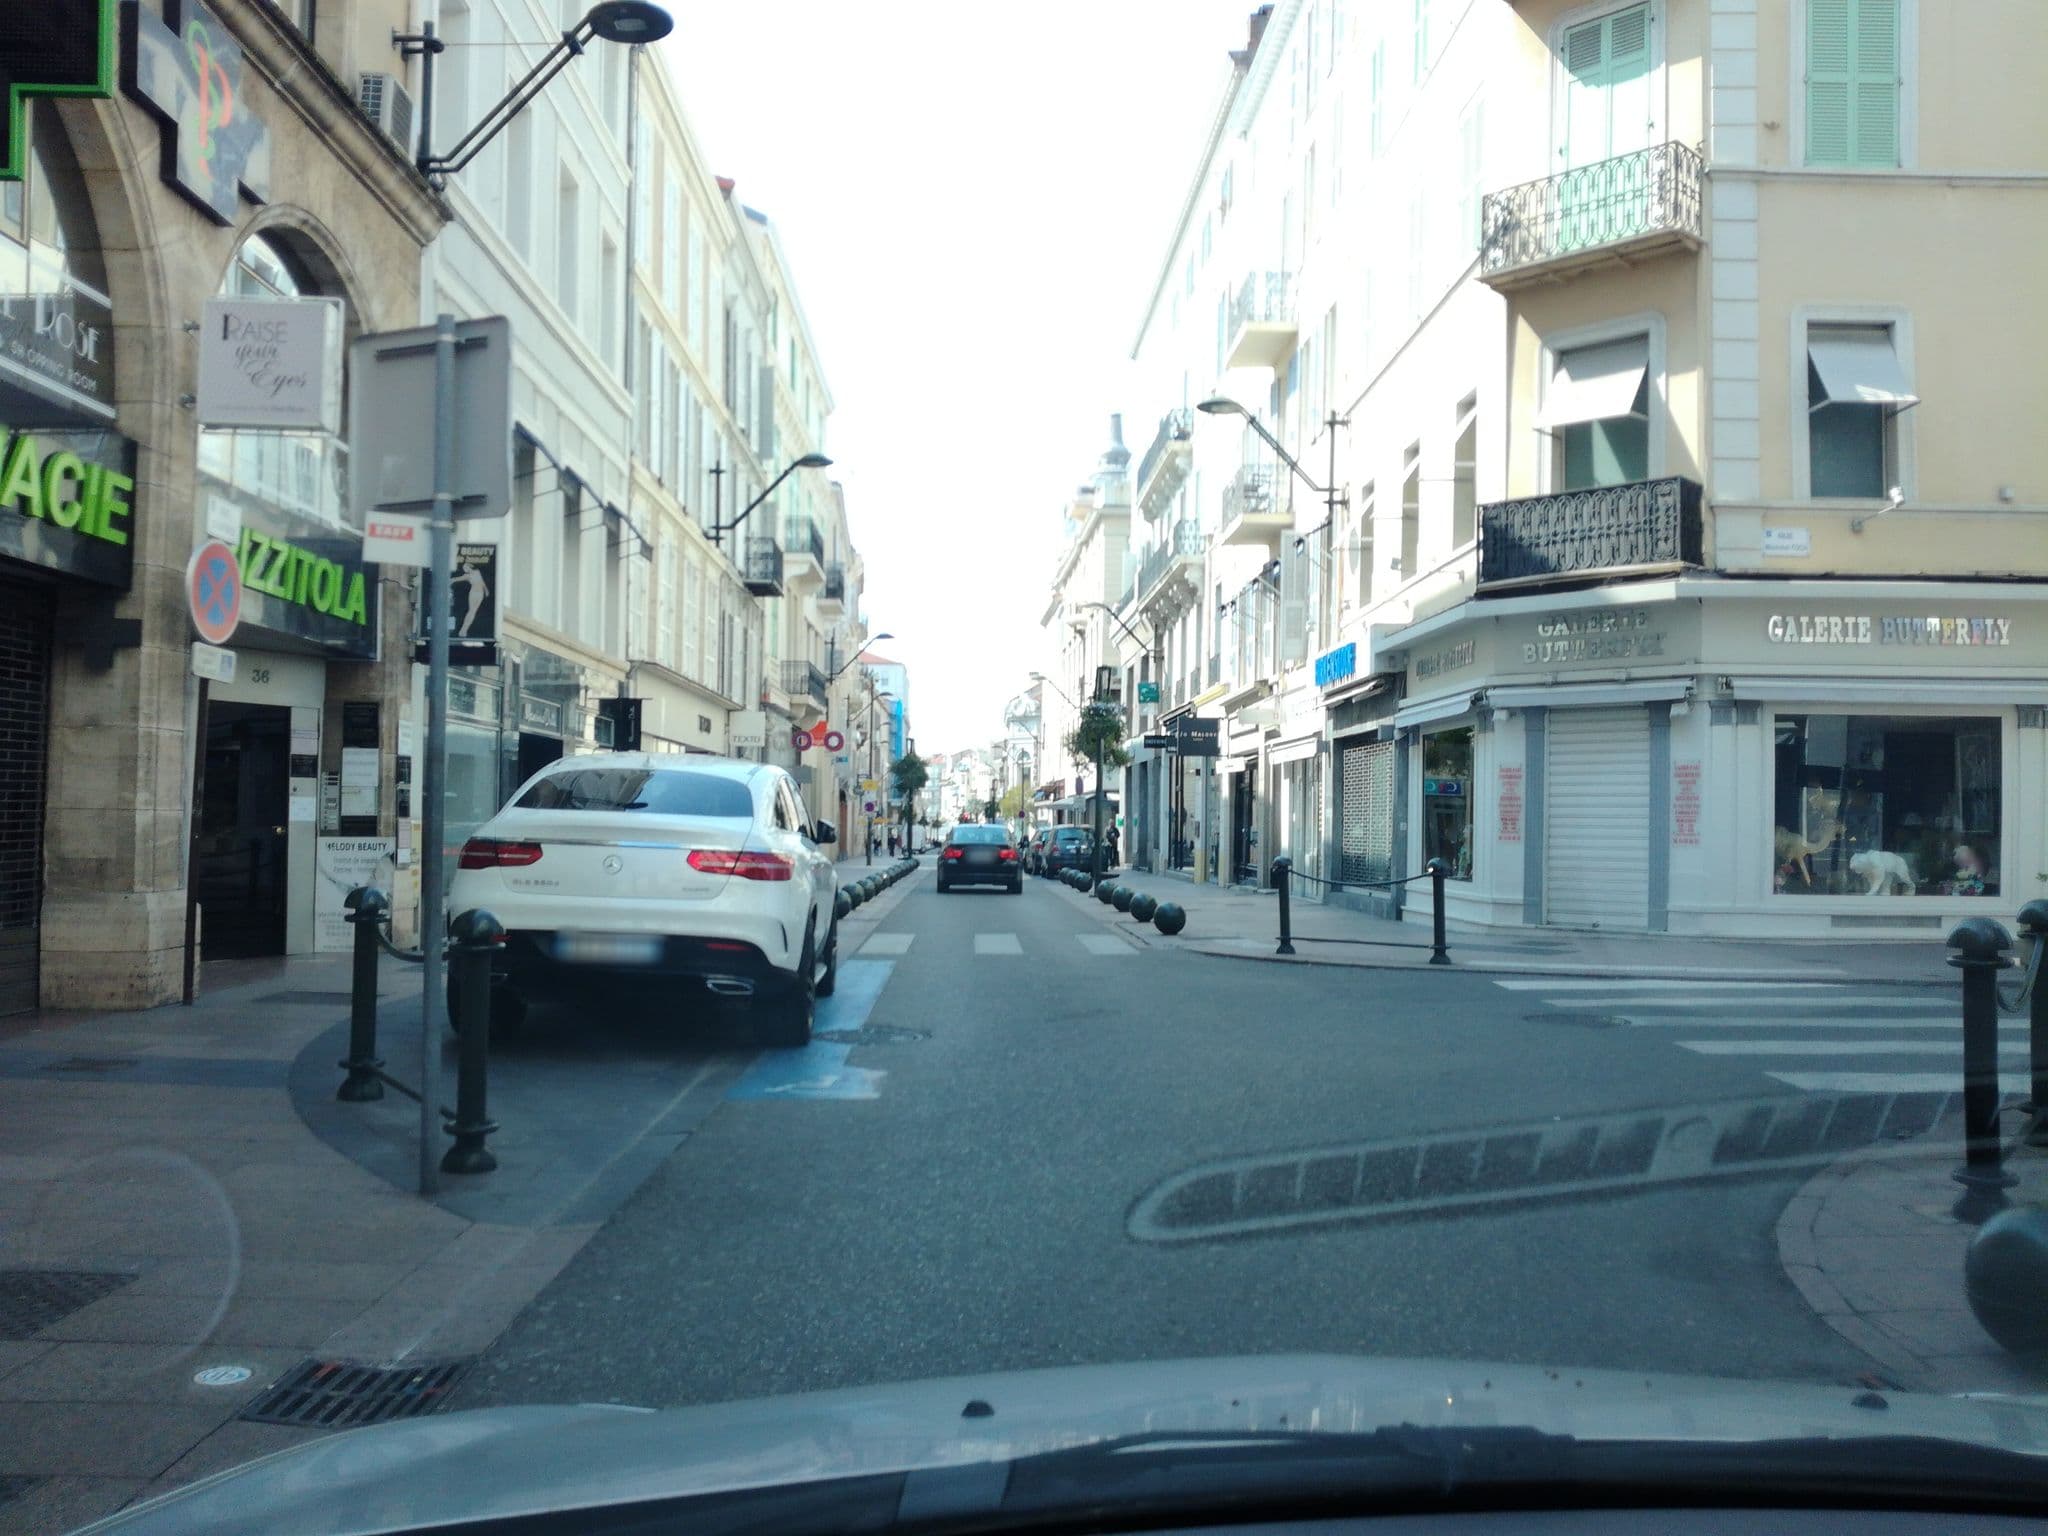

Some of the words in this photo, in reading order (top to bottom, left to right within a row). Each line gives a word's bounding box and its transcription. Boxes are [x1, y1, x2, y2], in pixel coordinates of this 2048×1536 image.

[222, 313, 288, 343] RAISE
[0, 424, 133, 545] ACIE
[229, 527, 367, 625] IZZITOLA
[1537, 611, 1650, 638] GALERIE
[1768, 615, 1872, 643] GALERIE
[1881, 617, 2011, 646] BUTTERFLY
[252, 669, 270, 684] 36
[357, 842, 388, 851] BEAUTY
